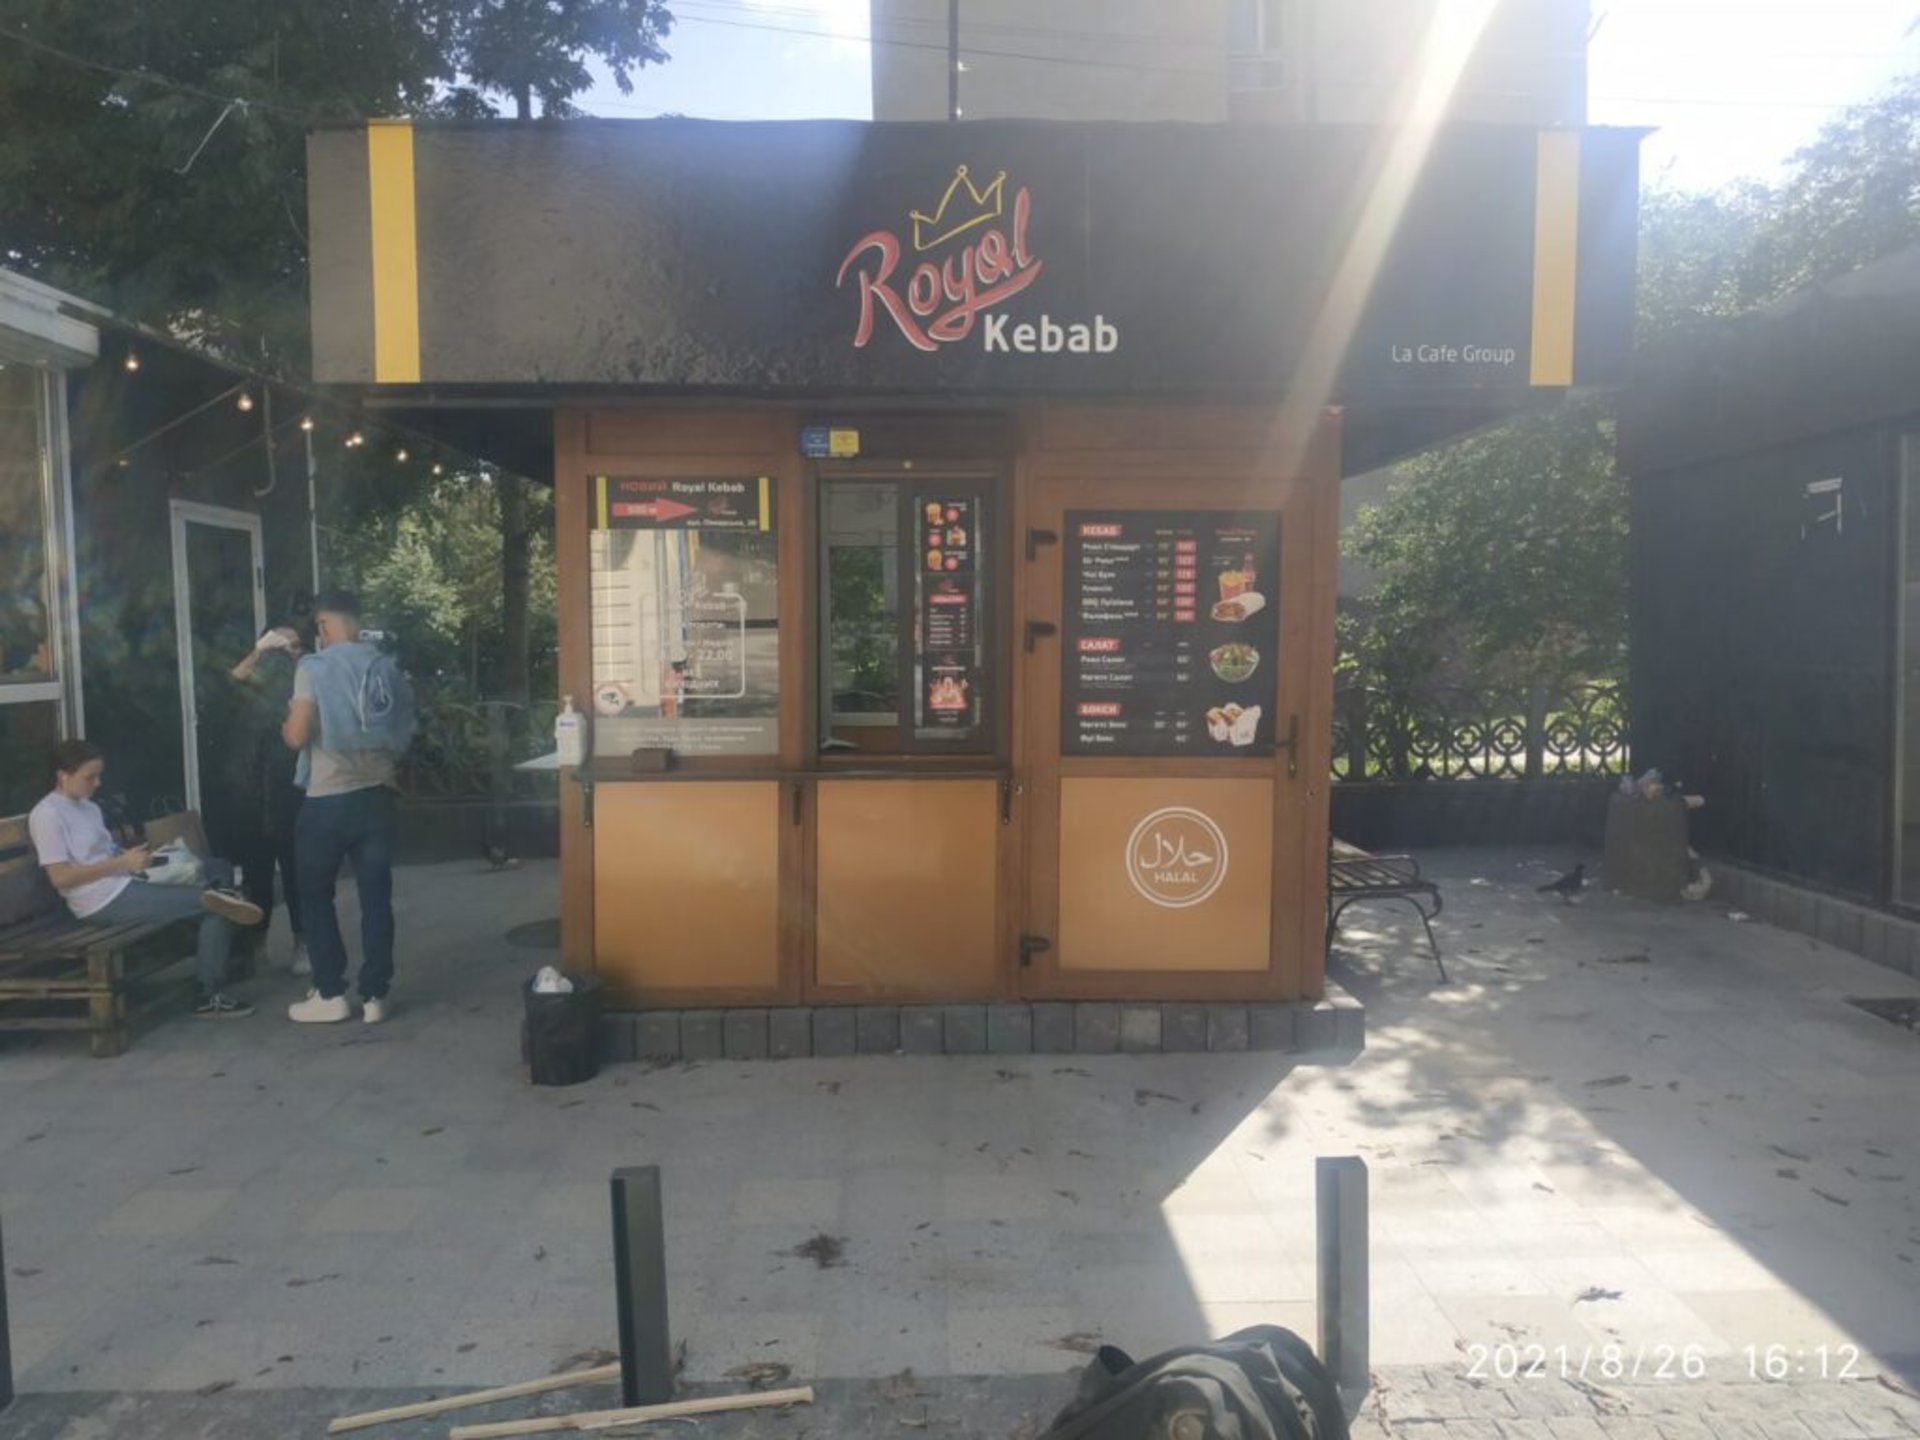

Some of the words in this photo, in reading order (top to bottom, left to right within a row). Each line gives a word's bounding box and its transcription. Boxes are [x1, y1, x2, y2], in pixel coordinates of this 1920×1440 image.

[836, 185, 1043, 351] Royal
[983, 314, 1119, 352] Kebab
[1392, 344, 1413, 362] La
[1418, 344, 1458, 362] Cafe
[1463, 344, 1515, 366] Group
[672, 481, 706, 493] Royal
[708, 481, 745, 493] Kebab
[1140, 832, 1213, 869] حلال
[1154, 871, 1199, 883] HALAL
